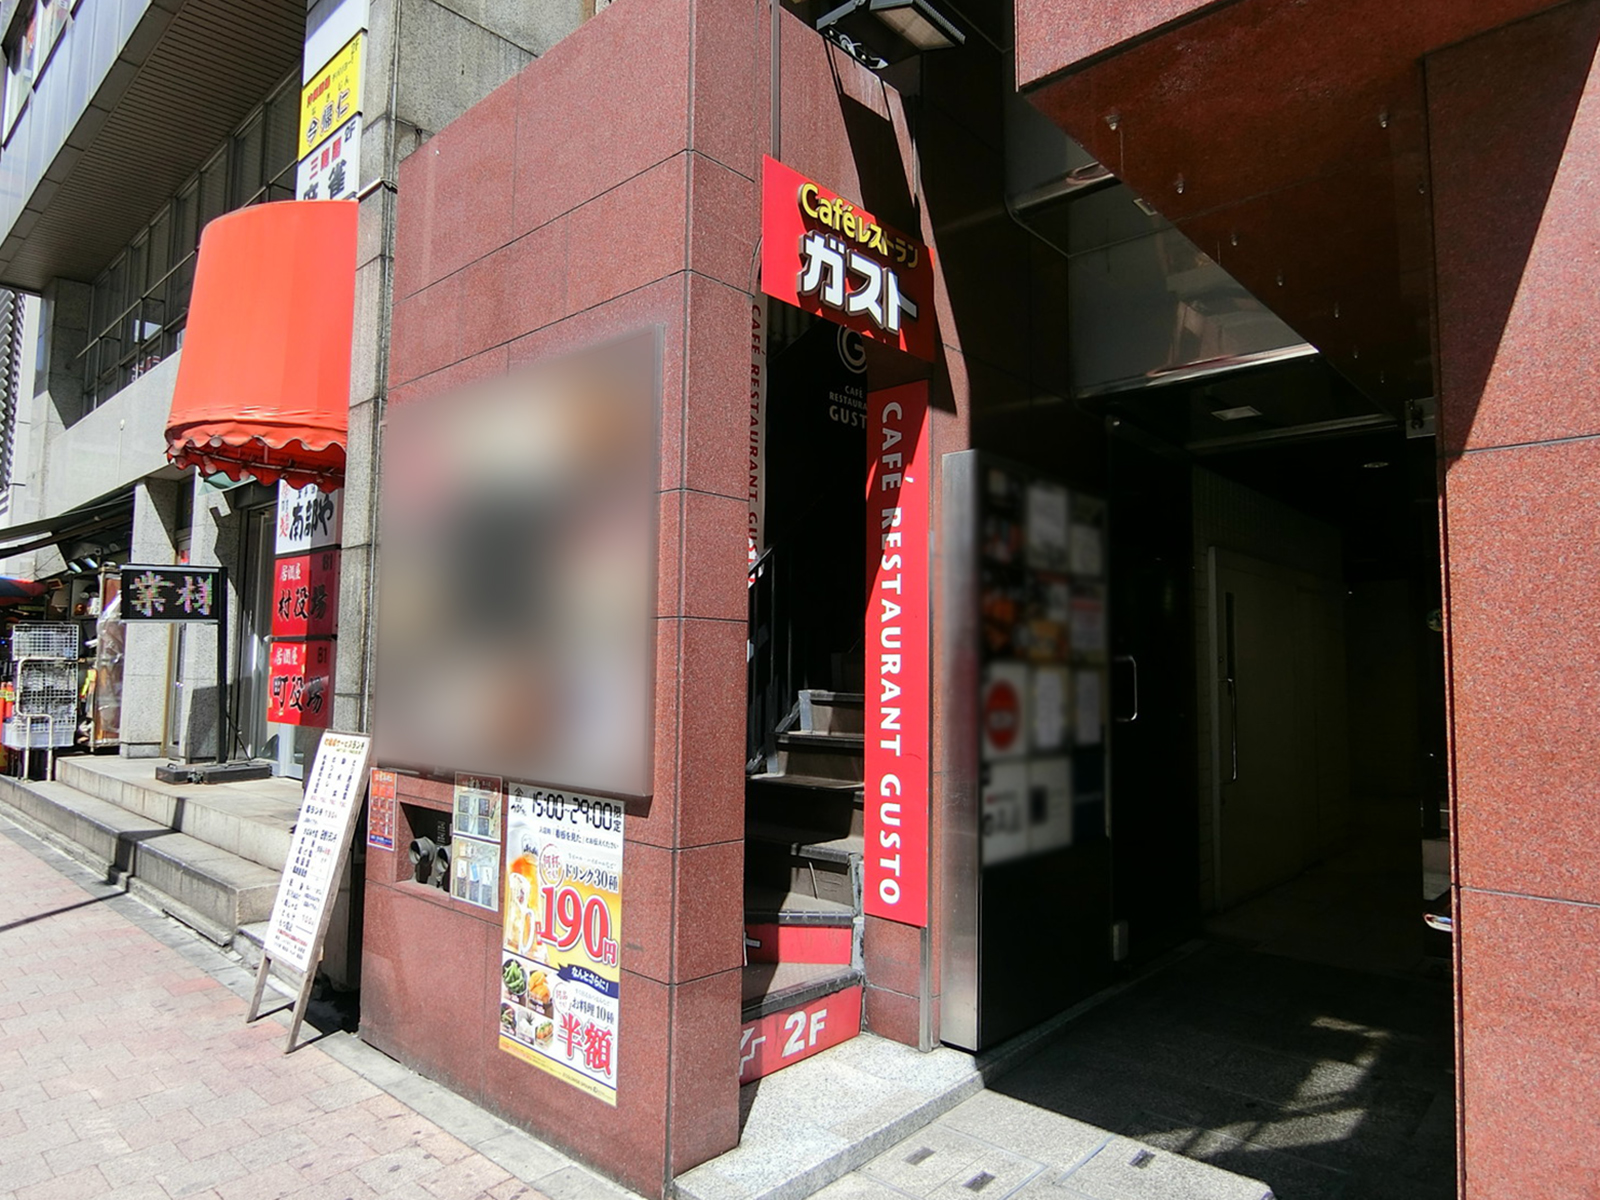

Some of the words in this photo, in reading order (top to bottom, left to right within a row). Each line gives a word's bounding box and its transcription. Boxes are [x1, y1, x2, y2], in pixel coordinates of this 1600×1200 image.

[800, 230, 918, 334] ガスト
[844, 385, 864, 399] CAFÉ
[749, 361, 760, 502] RESTAURANT
[280, 562, 301, 582] 居酒屋
[322, 553, 333, 571] B1
[278, 584, 328, 622] 村役場
[880, 506, 902, 757] RESTAURANT
[274, 647, 299, 666] 居酒屋
[317, 647, 328, 664] B1
[272, 675, 325, 714] 町役場
[879, 773, 901, 906] GUSTO
[565, 863, 618, 892] ドリンク30種
[557, 1012, 613, 1076] 半額
[781, 1008, 828, 1058] 2F
